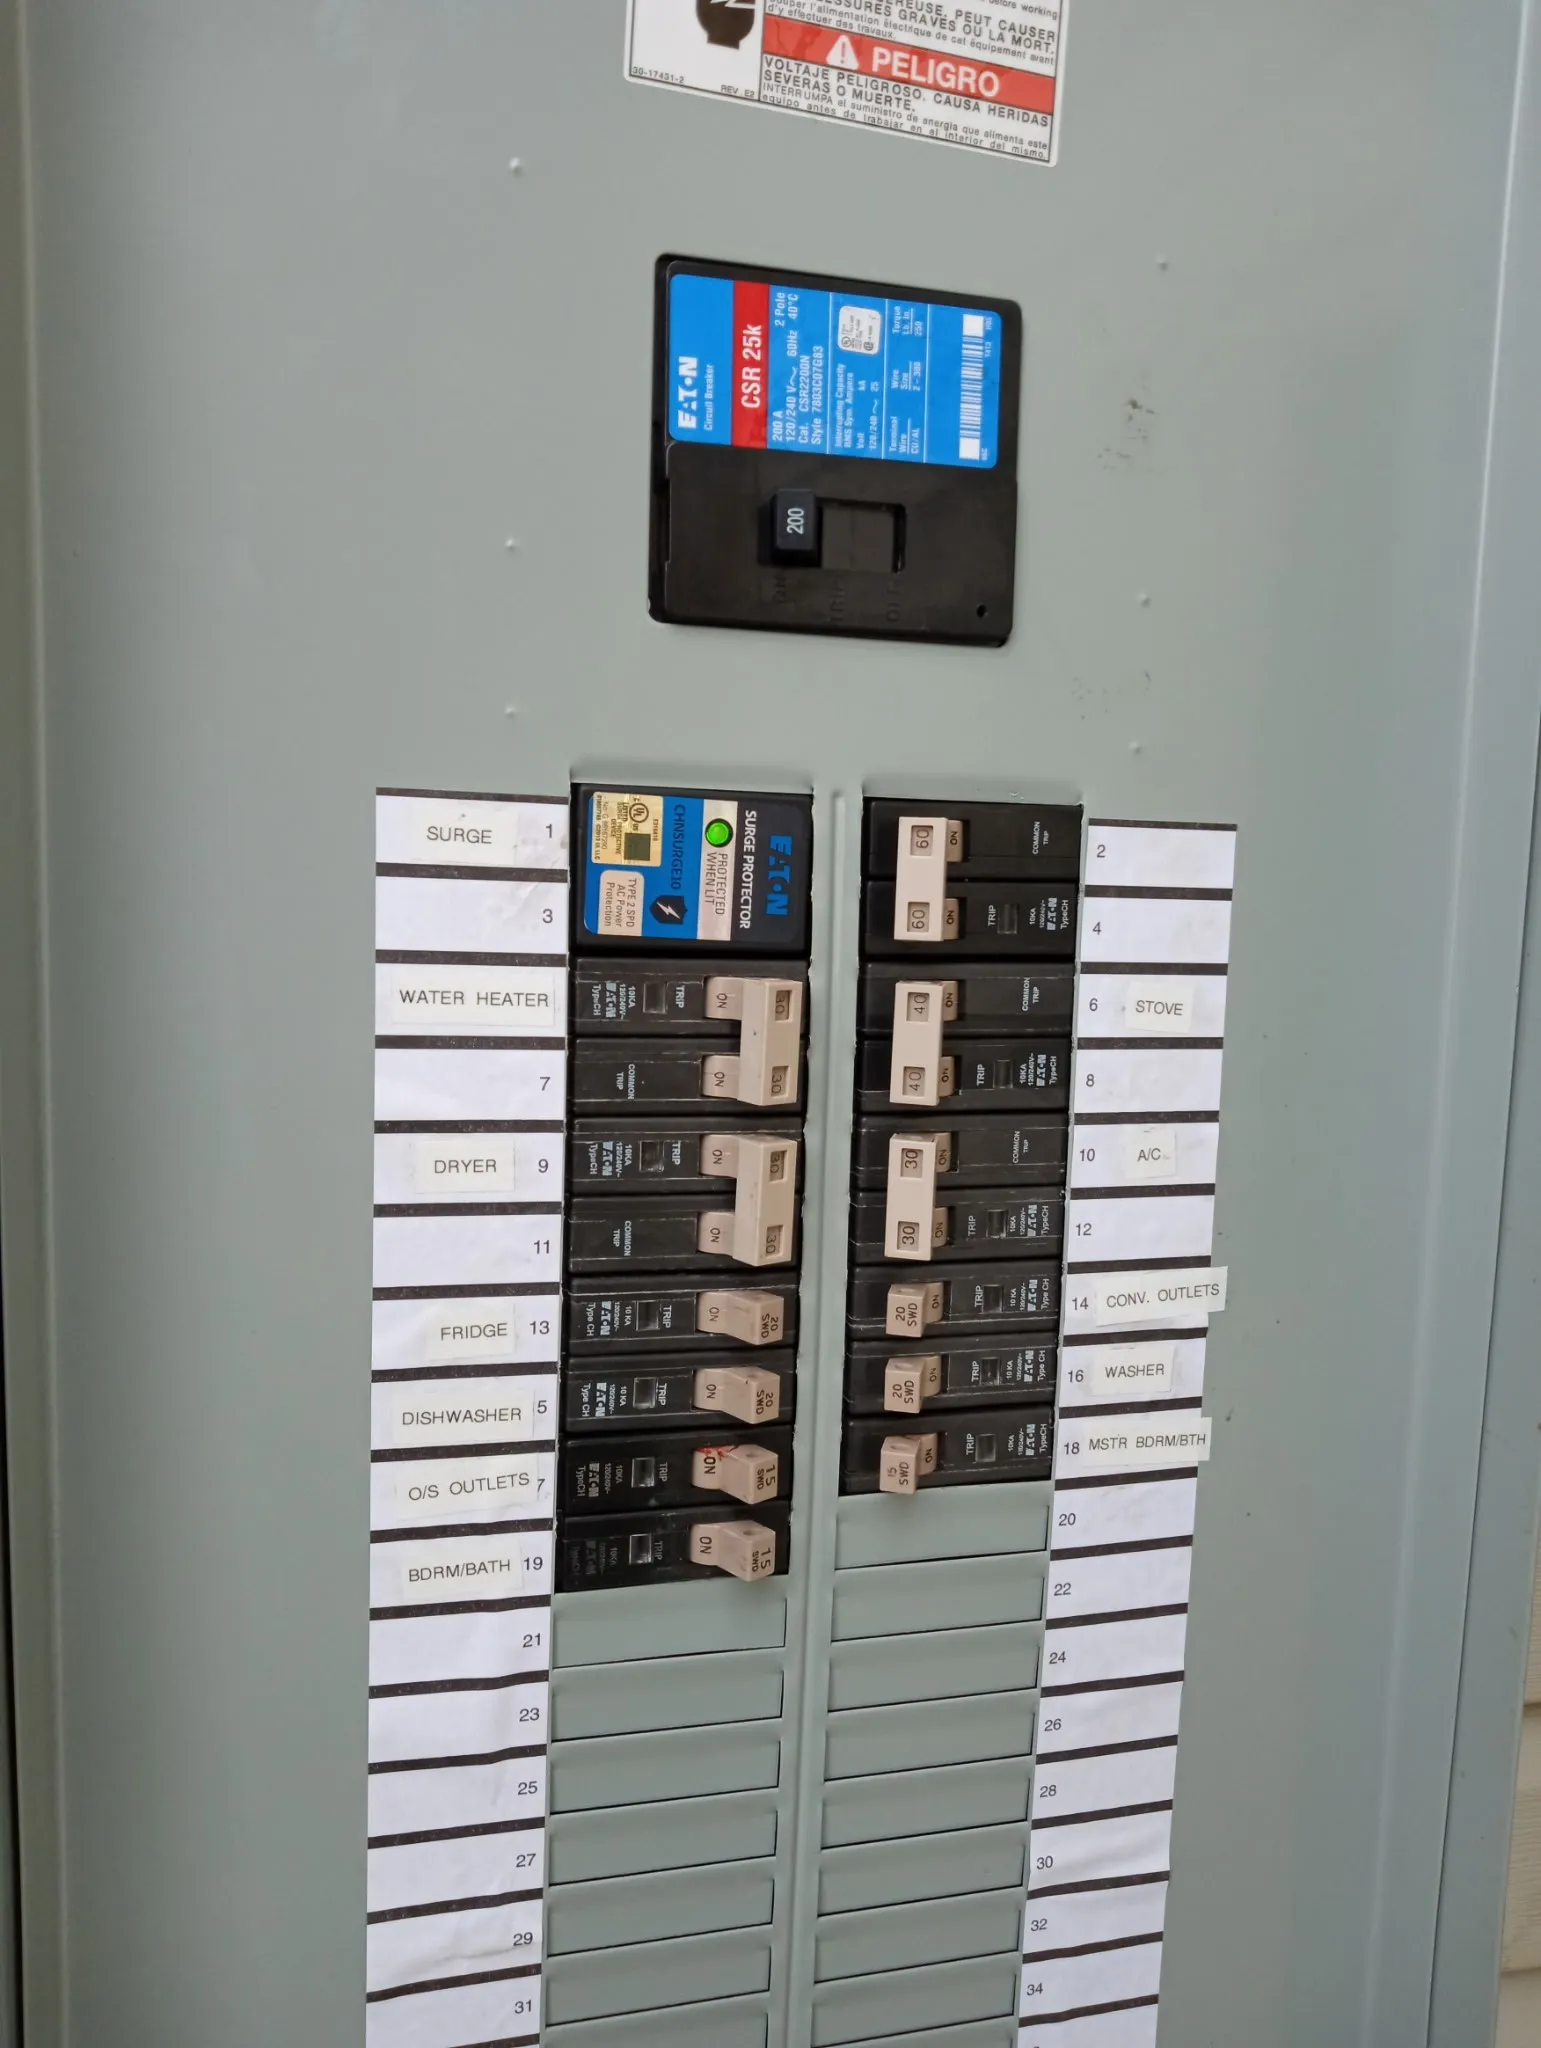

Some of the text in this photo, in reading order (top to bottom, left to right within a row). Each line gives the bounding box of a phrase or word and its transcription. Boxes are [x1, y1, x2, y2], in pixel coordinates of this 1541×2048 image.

[900, 9, 1054, 54] GRAVES OU LA MORT.
[955, 10, 1055, 42] PEUT CAUSER
[872, 46, 1000, 98] PELIGRO
[744, 90, 755, 98] E2
[764, 70, 916, 112] SEVERAS O MUERTE.
[765, 56, 1048, 127] VOLTAJE PELIGROSO. CAUSA HERIDAS
[762, 93, 800, 108] equipo
[807, 103, 836, 116] antes
[844, 108, 856, 119] de
[910, 125, 922, 134] en
[928, 128, 938, 138] el
[945, 129, 984, 146] interior
[990, 139, 1005, 150] del
[763, 83, 1048, 150] INTERRUMPA el suministro de que alimenta este
[775, 292, 786, 316] Pole
[741, 324, 762, 408] CSR 25k
[786, 294, 799, 442] 120/240 60Hz 40°C
[799, 356, 812, 412] CSR2200N
[704, 364, 714, 431] Circuit Breaker
[772, 410, 784, 442] 200 A
[812, 418, 822, 444] Style
[786, 508, 804, 534] 200
[426, 826, 493, 845] SURGE
[545, 824, 554, 838] 1
[916, 829, 930, 848] 60
[1096, 845, 1106, 858] 2
[740, 810, 757, 929] SURGE PROTECTOR
[628, 878, 637, 898] TYPE
[704, 852, 716, 906] WHEN LIT
[716, 852, 728, 915] PROTECTED
[604, 882, 616, 926] Protection
[615, 884, 626, 928] AC Power
[542, 909, 554, 924] 3
[626, 909, 636, 927] SPD
[912, 910, 926, 930] 60
[988, 904, 996, 926] TRIP
[1092, 922, 1102, 936] 4
[399, 990, 550, 1008] WATER HEATER
[676, 984, 685, 1008] TRIP
[716, 993, 728, 1008] ON
[914, 994, 927, 1014] 40
[1089, 998, 1098, 1012] 6
[1136, 1000, 1184, 1016] STOVE
[540, 1076, 551, 1092] 7
[714, 1072, 725, 1088] ON
[772, 1074, 783, 1094] 30
[910, 1071, 922, 1092] 40
[976, 1064, 986, 1086] TRIP
[1086, 1074, 1094, 1088] 8
[672, 1142, 682, 1166] TRIP
[712, 1149, 722, 1165] ON
[904, 1150, 918, 1170] 30
[938, 1148, 948, 1166] ON
[1079, 1149, 1096, 1162] 10
[1137, 1148, 1161, 1162] A/C
[434, 1159, 498, 1174] DRYER
[538, 1158, 549, 1174] 9
[935, 1222, 944, 1238] ON
[968, 1215, 976, 1236] TRIP
[1075, 1223, 1092, 1237] 12
[710, 1228, 720, 1244] ON
[766, 1235, 777, 1254] 30
[902, 1226, 916, 1245] 30
[533, 1240, 551, 1255] 11
[975, 1285, 984, 1308] TRIP
[1072, 1298, 1088, 1311] 14
[1106, 1284, 1220, 1308] CONV. OUTLETS
[662, 1305, 672, 1328] TRIP
[709, 1306, 720, 1322] ON
[896, 1306, 906, 1322] 20
[908, 1302, 918, 1327] SWD
[440, 1323, 508, 1341] FRIDGE
[529, 1321, 550, 1336] 13
[761, 1314, 770, 1338] SWD
[770, 1316, 779, 1332] 20
[972, 1360, 980, 1382] TRIP
[1067, 1370, 1084, 1384] 16
[1104, 1364, 1164, 1378] WASHER
[658, 1383, 668, 1406] TRIP
[706, 1384, 716, 1400] ON
[765, 1392, 774, 1408] 20
[892, 1384, 902, 1399] 20
[904, 1380, 914, 1404] SWD
[537, 1400, 548, 1414] 5
[756, 1390, 764, 1415] SWD
[402, 1408, 522, 1426] DISHWASHER
[966, 1434, 974, 1456] TRIP
[1063, 1442, 1080, 1456] 18
[1088, 1433, 1206, 1451] MSTR BDRM/BTH
[704, 1456, 716, 1474] ON
[764, 1464, 776, 1487] 15
[408, 1472, 530, 1501] O/S OUTLETS
[537, 1479, 545, 1492] 7
[1058, 1512, 1076, 1526] 20
[700, 1536, 712, 1554] ON
[524, 1556, 544, 1571] 19
[760, 1548, 771, 1570] 15
[409, 1559, 511, 1582] BDRM/BATH
[1054, 1582, 1072, 1596] 22
[522, 1634, 542, 1648] 21
[1049, 1650, 1066, 1665] 24
[519, 1708, 540, 1722] 23
[1044, 1718, 1062, 1732] 26
[518, 1781, 538, 1796] 25
[1039, 1784, 1056, 1798] 28
[516, 1853, 536, 1868] 27
[1036, 1855, 1054, 1870] 30
[1030, 1918, 1048, 1932] 32
[513, 1932, 534, 1946] 29
[1026, 1982, 1044, 1996] 34
[514, 2000, 532, 2014] 31
